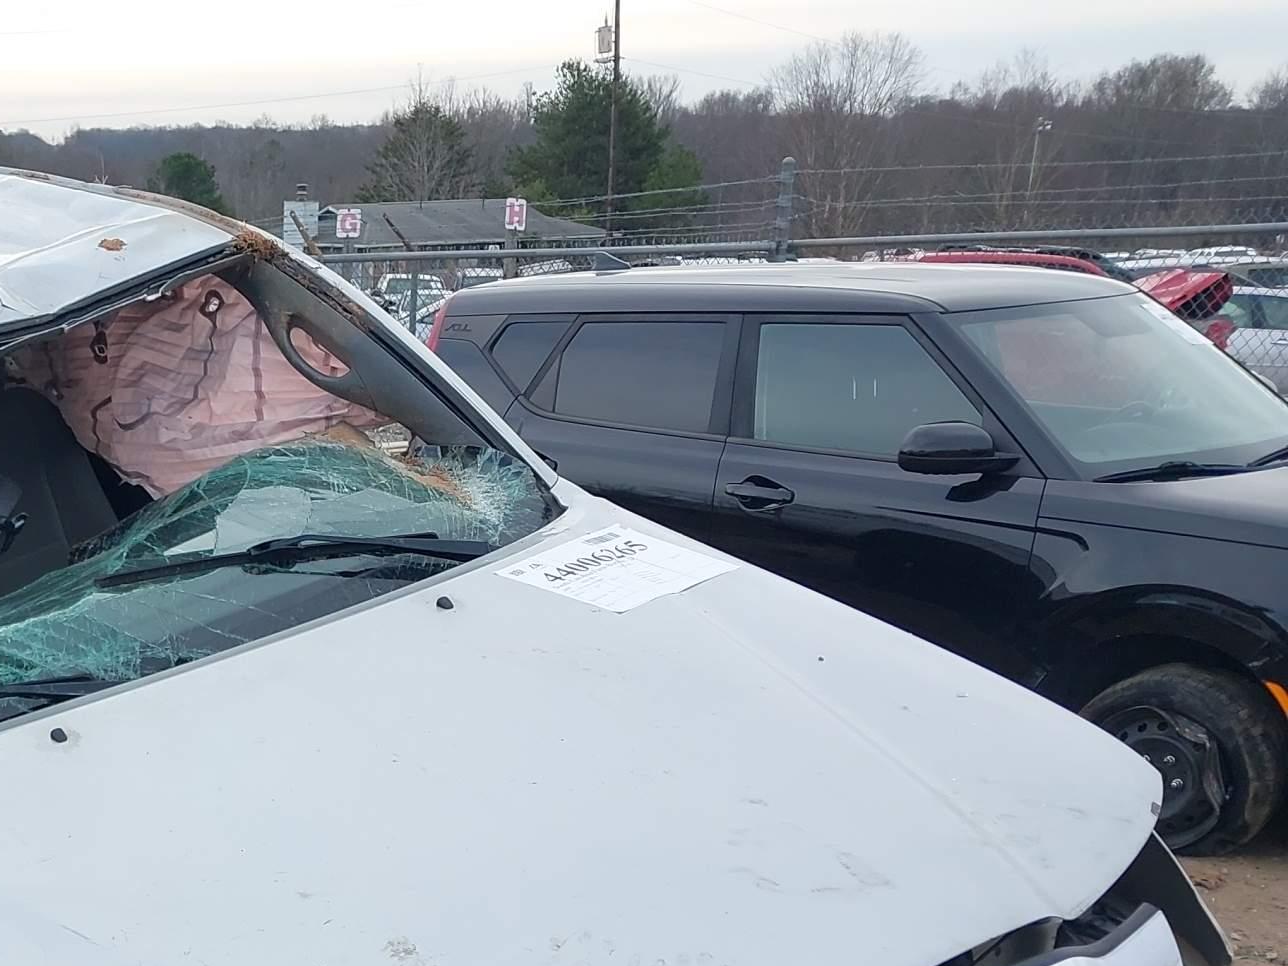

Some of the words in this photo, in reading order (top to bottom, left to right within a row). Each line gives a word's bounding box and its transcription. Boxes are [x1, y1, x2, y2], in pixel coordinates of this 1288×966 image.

[340, 213, 358, 234] G
[508, 202, 524, 227] H
[543, 540, 648, 582] 44006265
